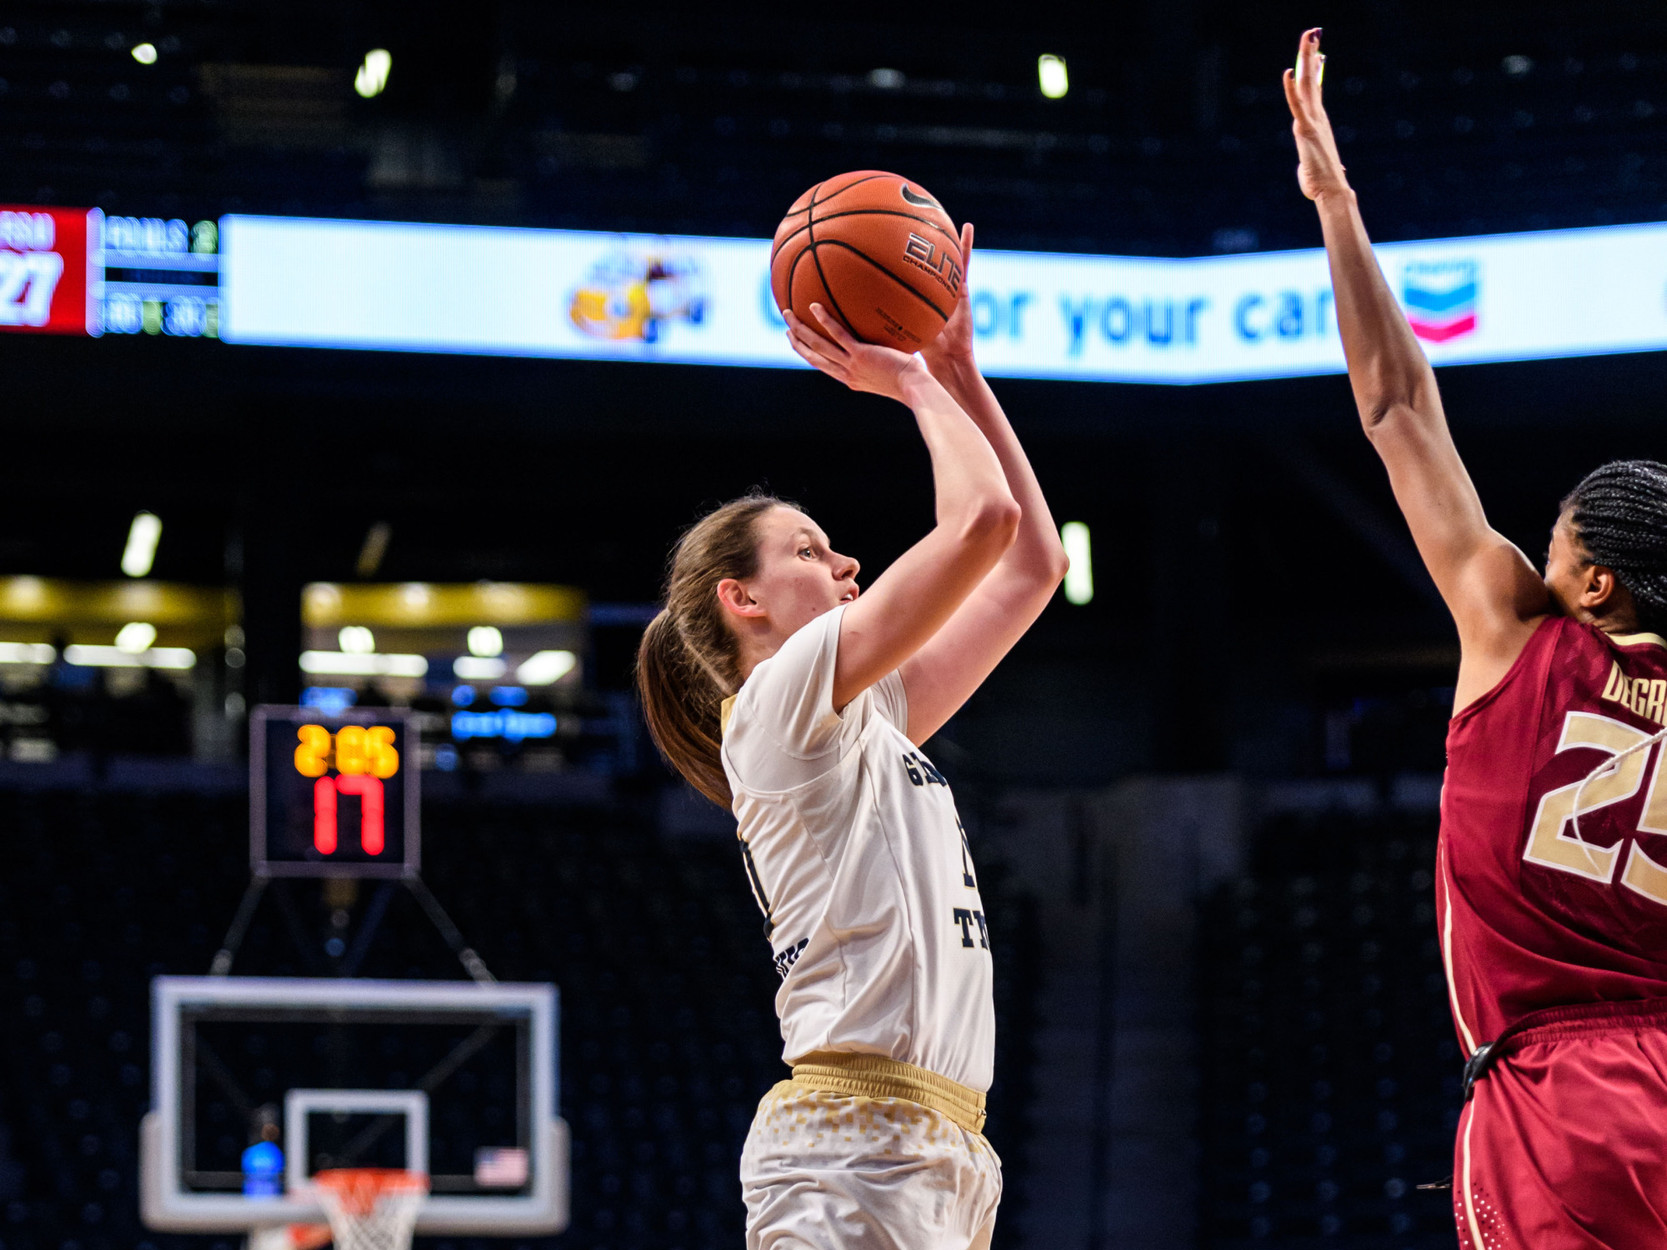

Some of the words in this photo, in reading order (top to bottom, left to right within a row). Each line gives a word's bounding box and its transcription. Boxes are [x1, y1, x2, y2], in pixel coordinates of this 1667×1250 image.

[905, 231, 962, 293] ELITE
[1057, 291, 1207, 357] your
[1601, 659, 1667, 728] DEGR
[313, 773, 385, 856] 17
